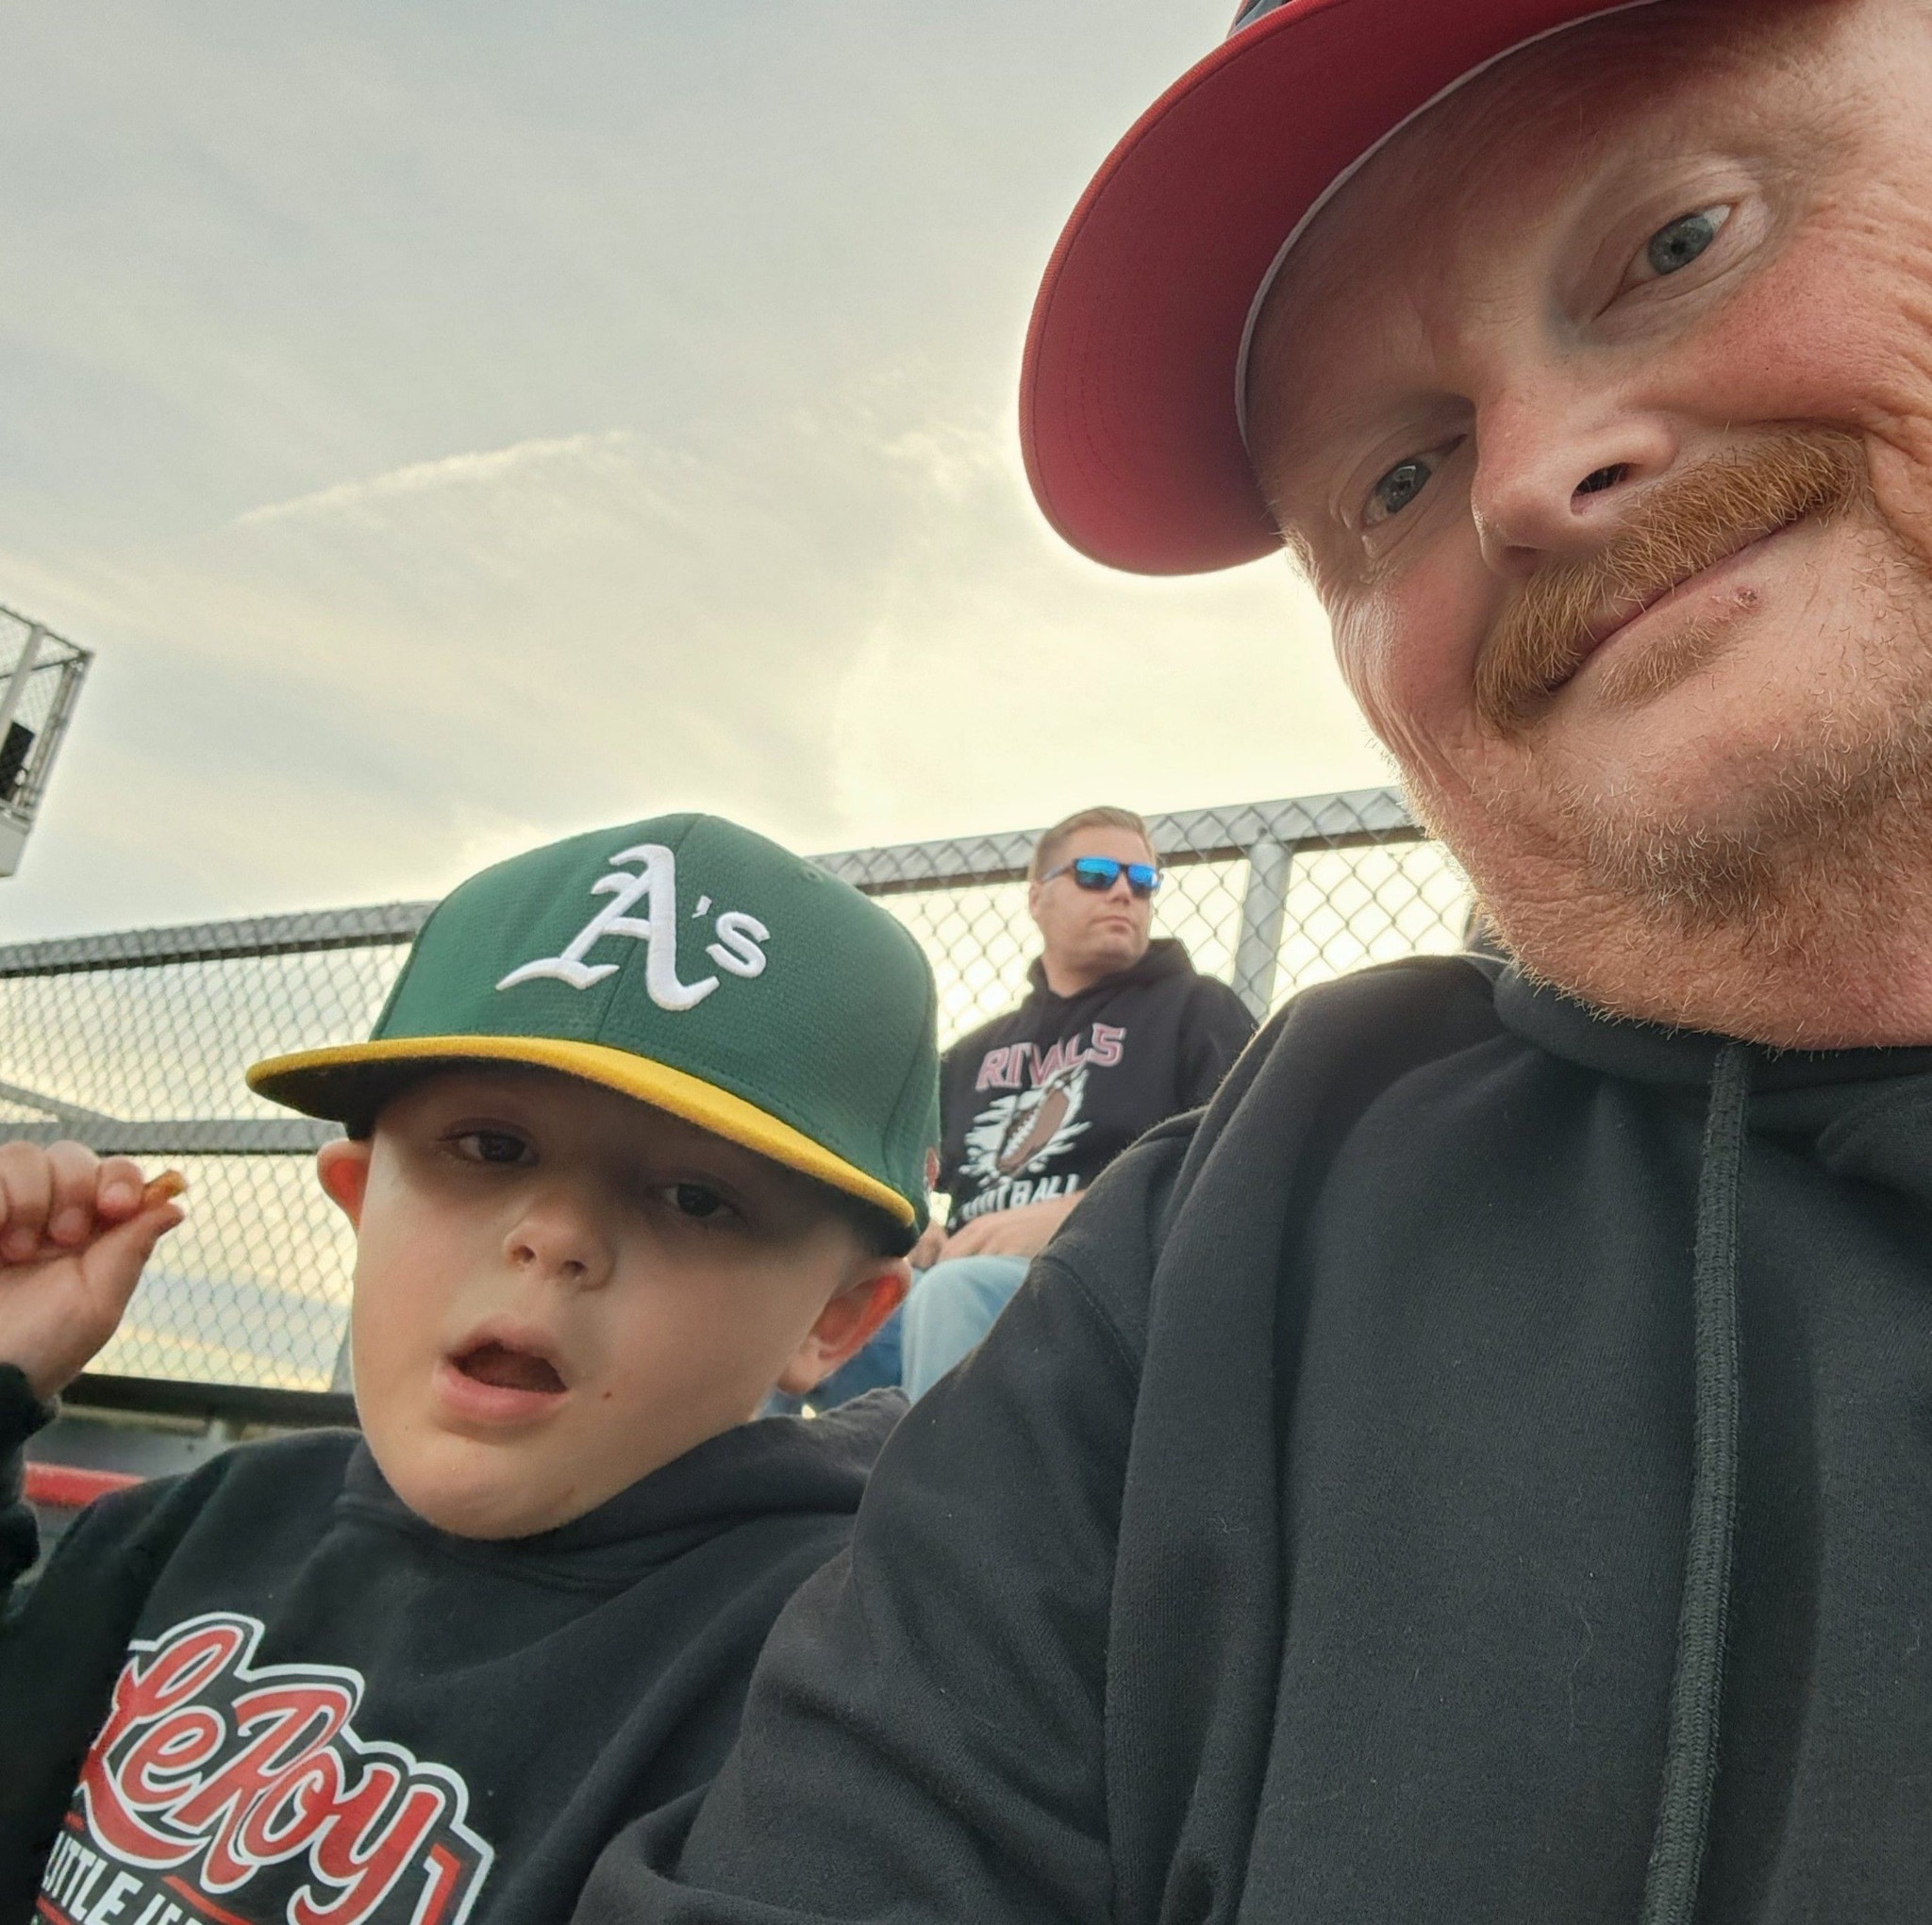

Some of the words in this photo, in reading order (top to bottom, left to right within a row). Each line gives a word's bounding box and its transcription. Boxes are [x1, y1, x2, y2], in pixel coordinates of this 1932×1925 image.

[495, 843, 771, 1011] A's
[974, 1021, 1127, 1091] RIVALS
[79, 1624, 449, 1925] LeRoy
